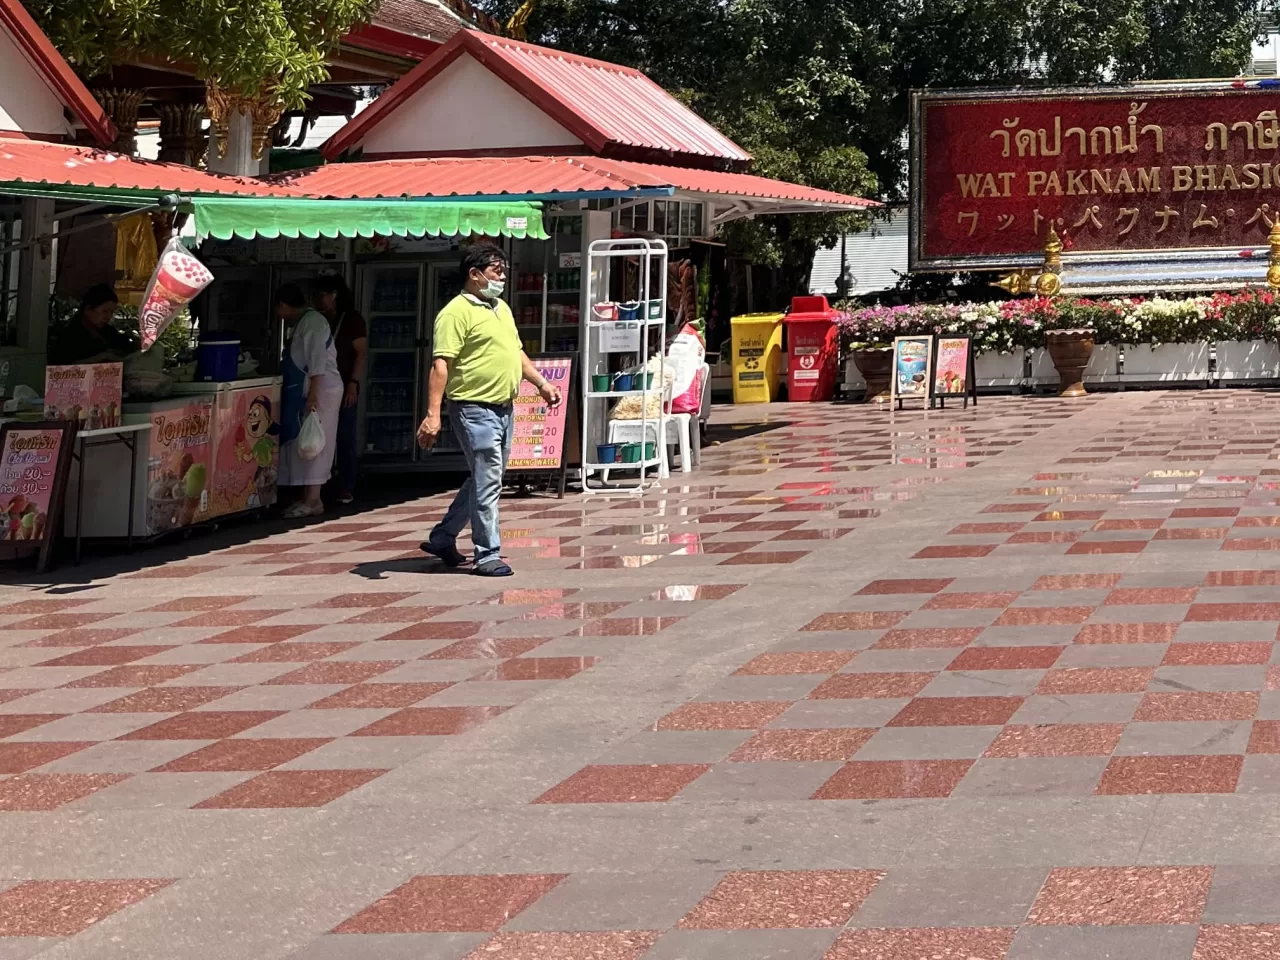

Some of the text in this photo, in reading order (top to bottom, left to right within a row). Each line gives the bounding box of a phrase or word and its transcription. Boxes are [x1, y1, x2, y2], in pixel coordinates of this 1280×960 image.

[989, 102, 1164, 157] วัดปากน้ำ
[957, 172, 1015, 198] WAT
[1027, 166, 1161, 197] PAKNAM
[536, 458, 558, 466] WATER
